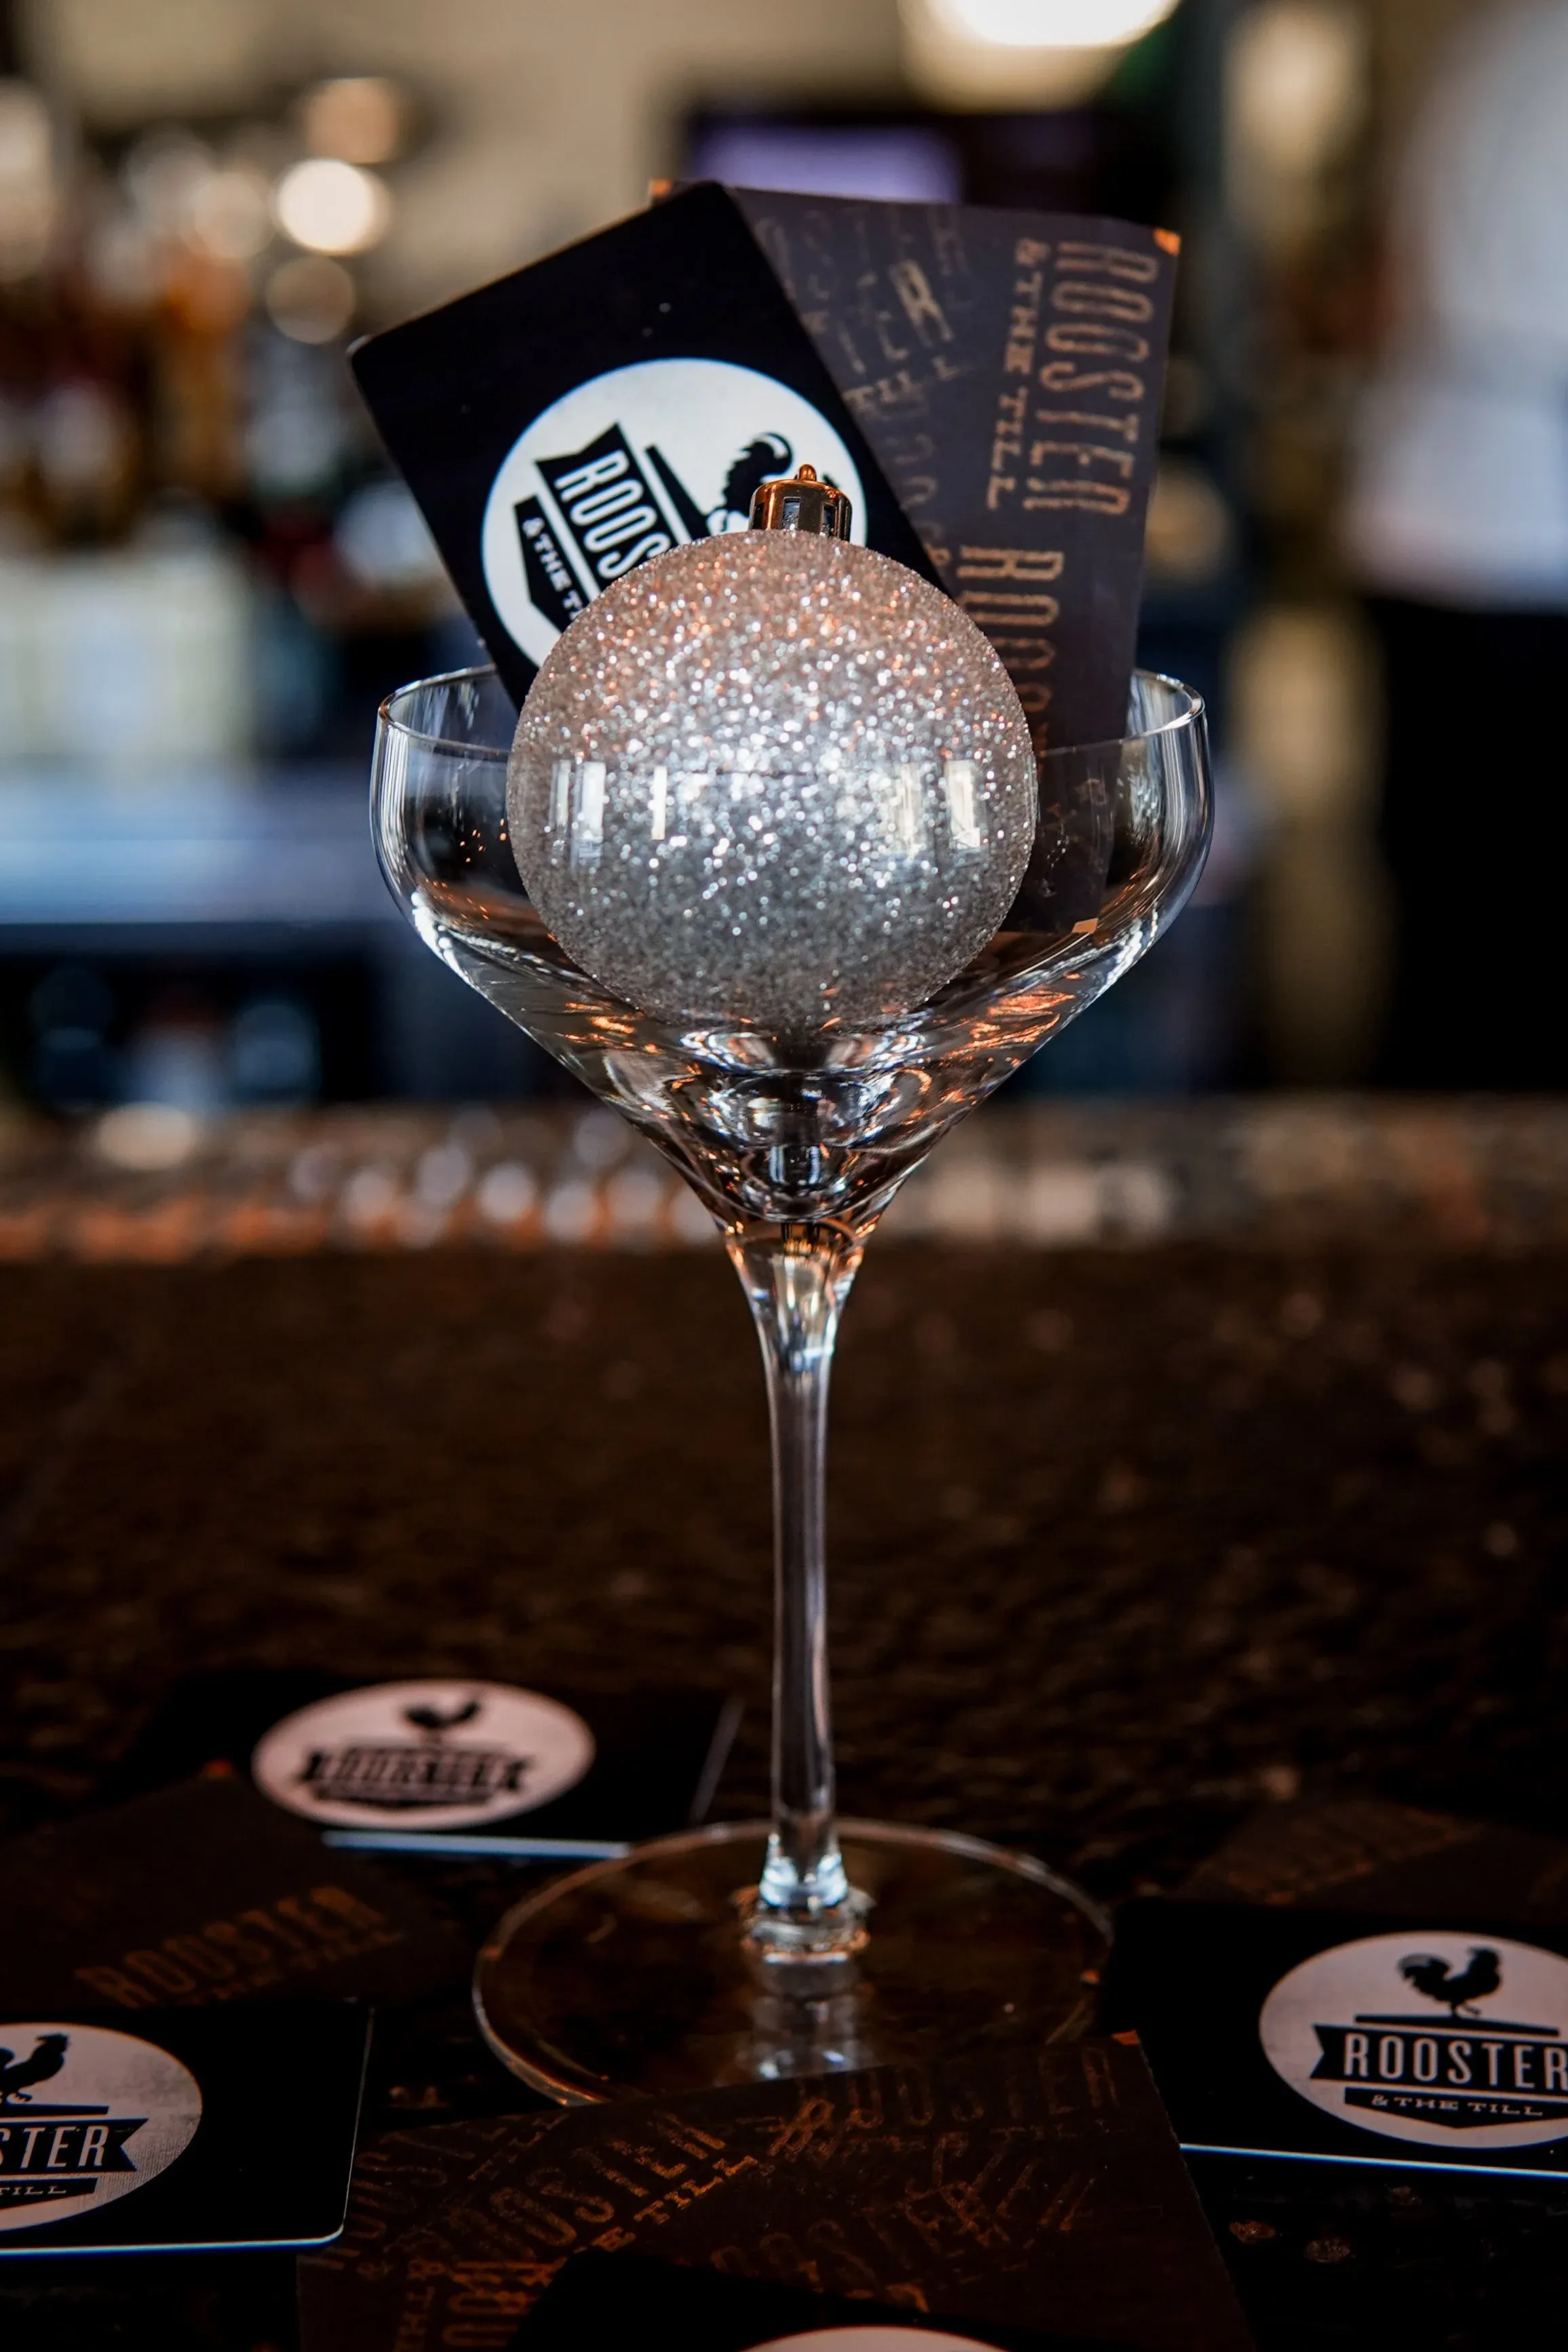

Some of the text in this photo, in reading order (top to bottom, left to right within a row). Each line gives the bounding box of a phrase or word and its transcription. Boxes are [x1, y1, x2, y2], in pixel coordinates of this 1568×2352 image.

[985, 237, 1051, 512] & THE TILL
[1020, 239, 1159, 516] ROOSTER
[522, 516, 545, 539] &
[533, 532, 572, 592] THE
[1343, 2032, 1568, 2092] ROOSTER
[1371, 2094, 1544, 2117] & THE TILL
[634, 2155, 759, 2225] TILL
